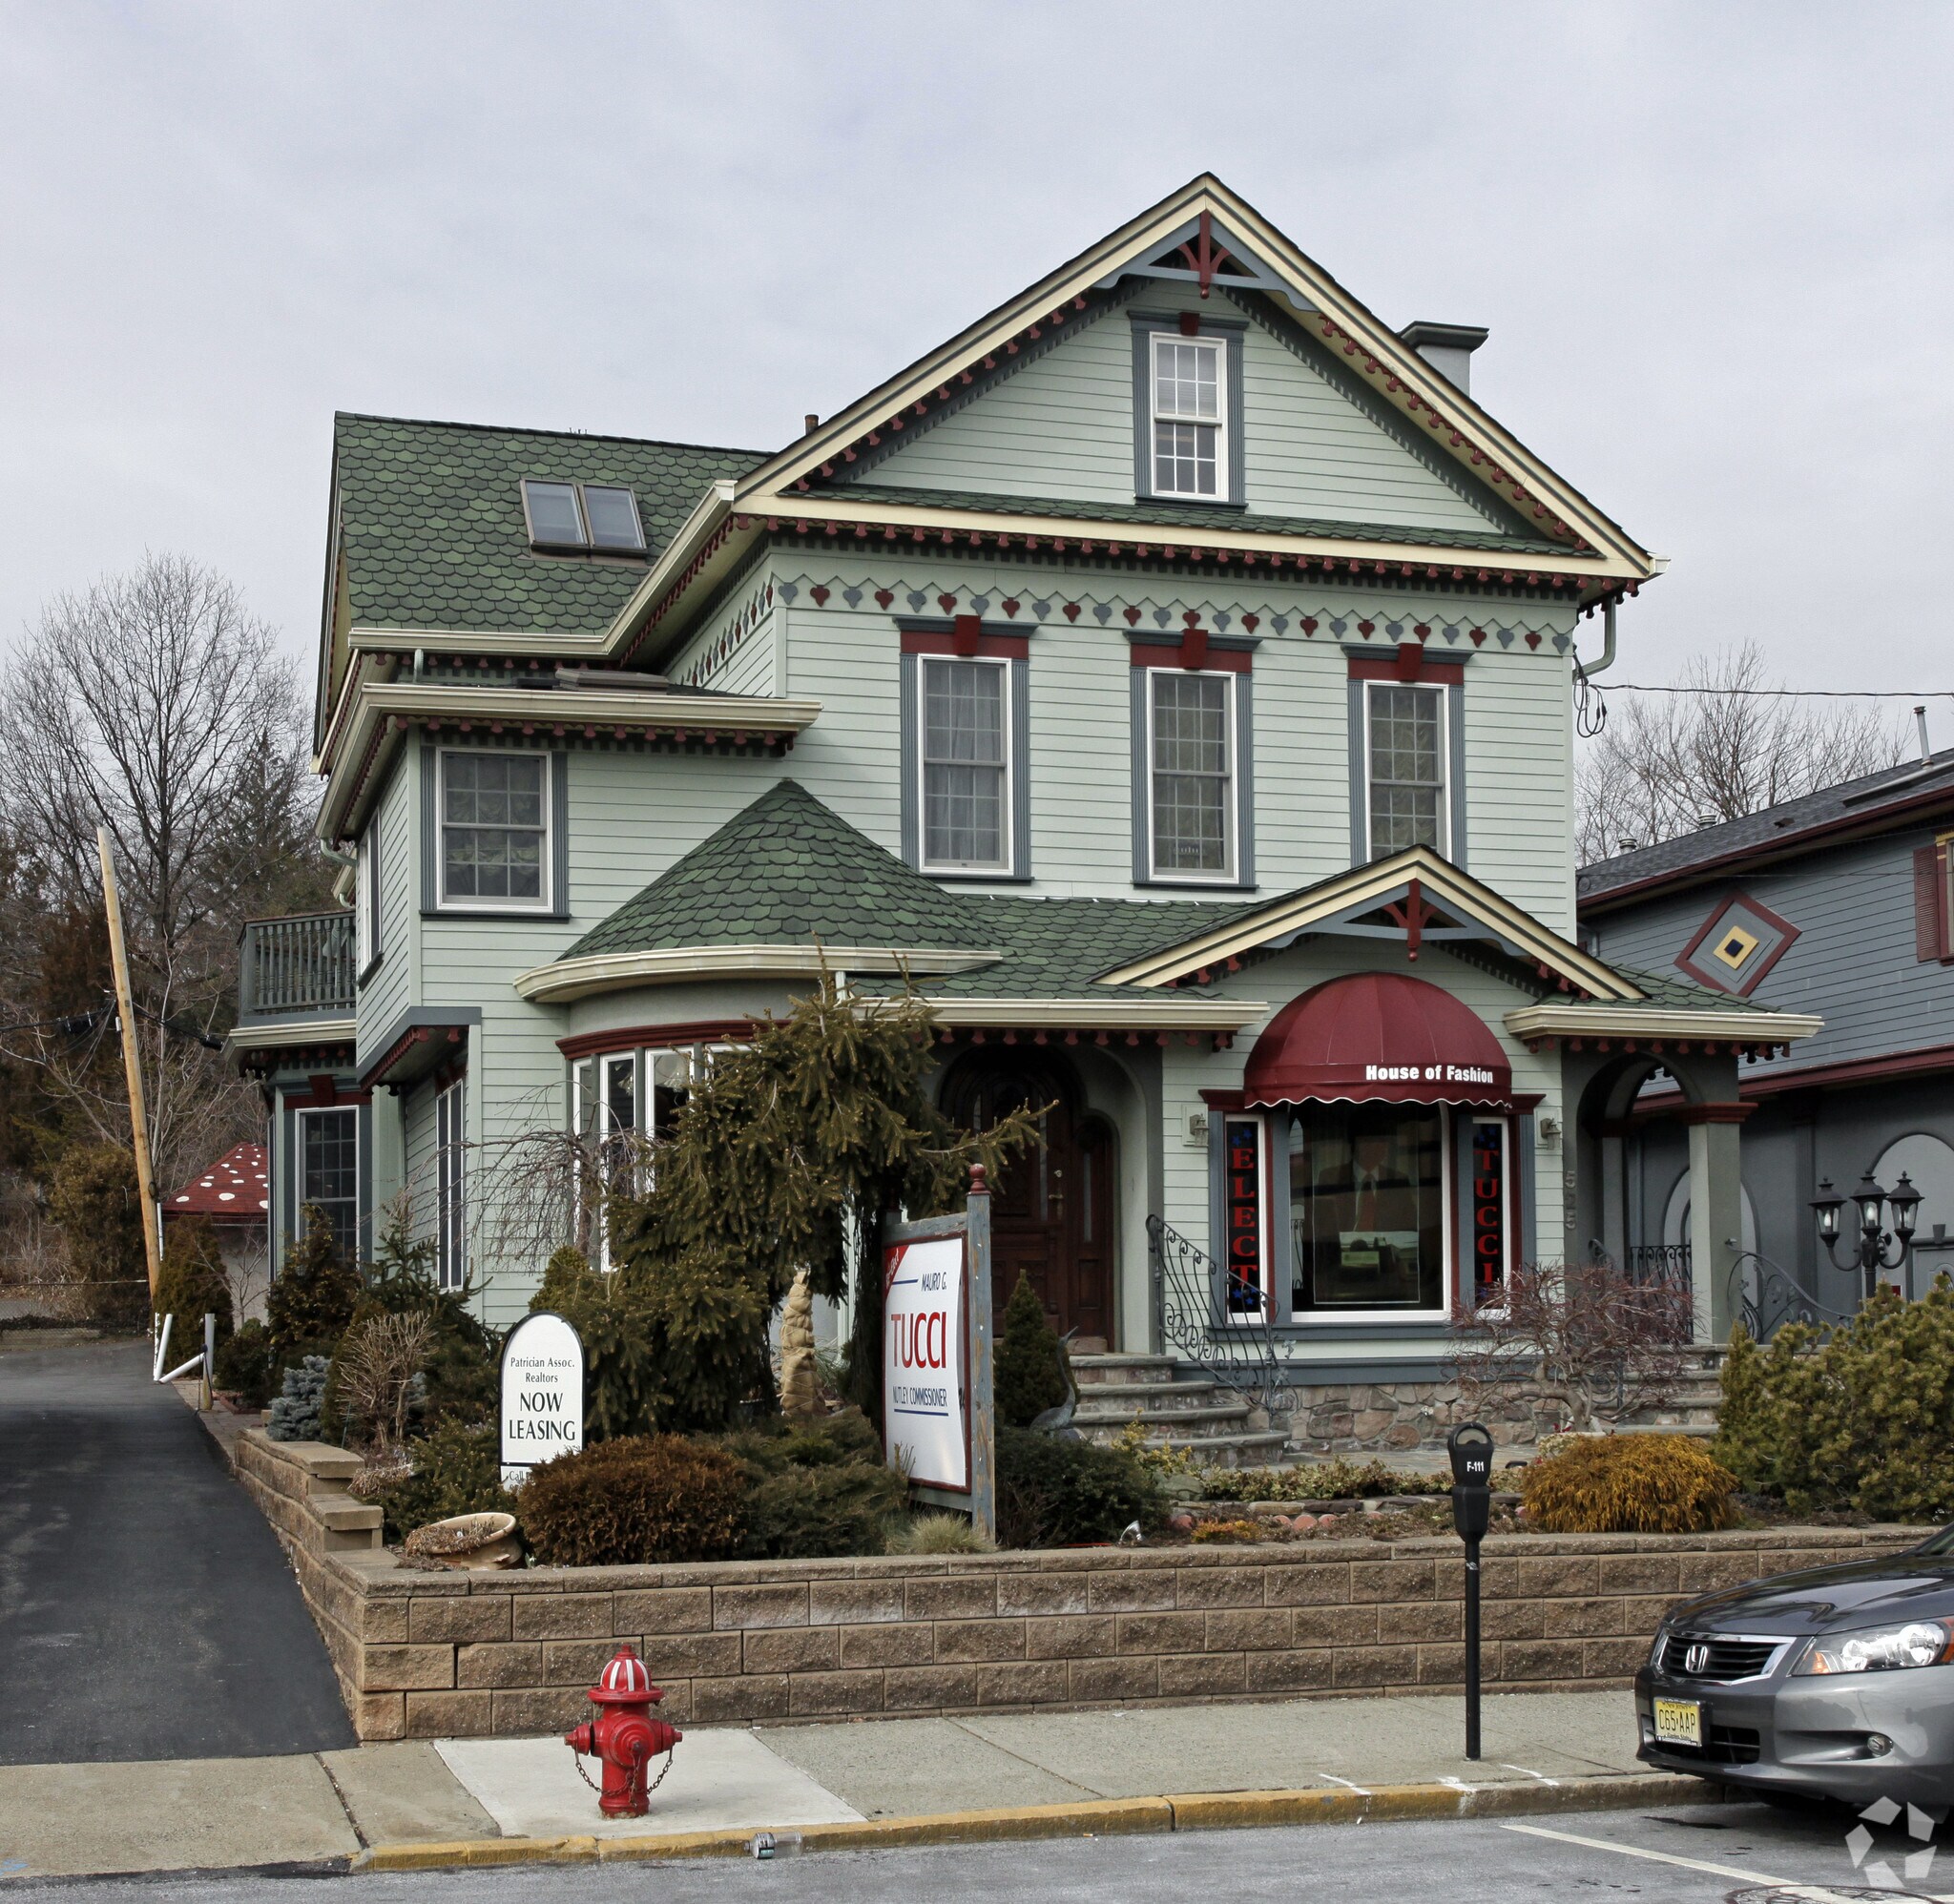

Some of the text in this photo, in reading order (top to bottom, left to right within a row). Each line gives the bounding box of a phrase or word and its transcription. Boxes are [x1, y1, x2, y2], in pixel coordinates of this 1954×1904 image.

[1366, 1065, 1493, 1084] House of Fashion
[1230, 1148, 1258, 1286] ELECT
[1473, 1149, 1499, 1283] TUCCI
[922, 1273, 941, 1292] MAURO
[891, 1312, 946, 1369] TUCCI
[510, 1356, 575, 1368] Patrician Assoc.
[526, 1372, 558, 1383] Realtors
[520, 1392, 563, 1412] NOW
[893, 1386, 909, 1404] NUTLEY
[909, 1387, 947, 1407] COMMISSIONER
[509, 1419, 575, 1441] LEASING
[509, 1470, 524, 1482] Call
[1466, 1461, 1484, 1472] F-111
